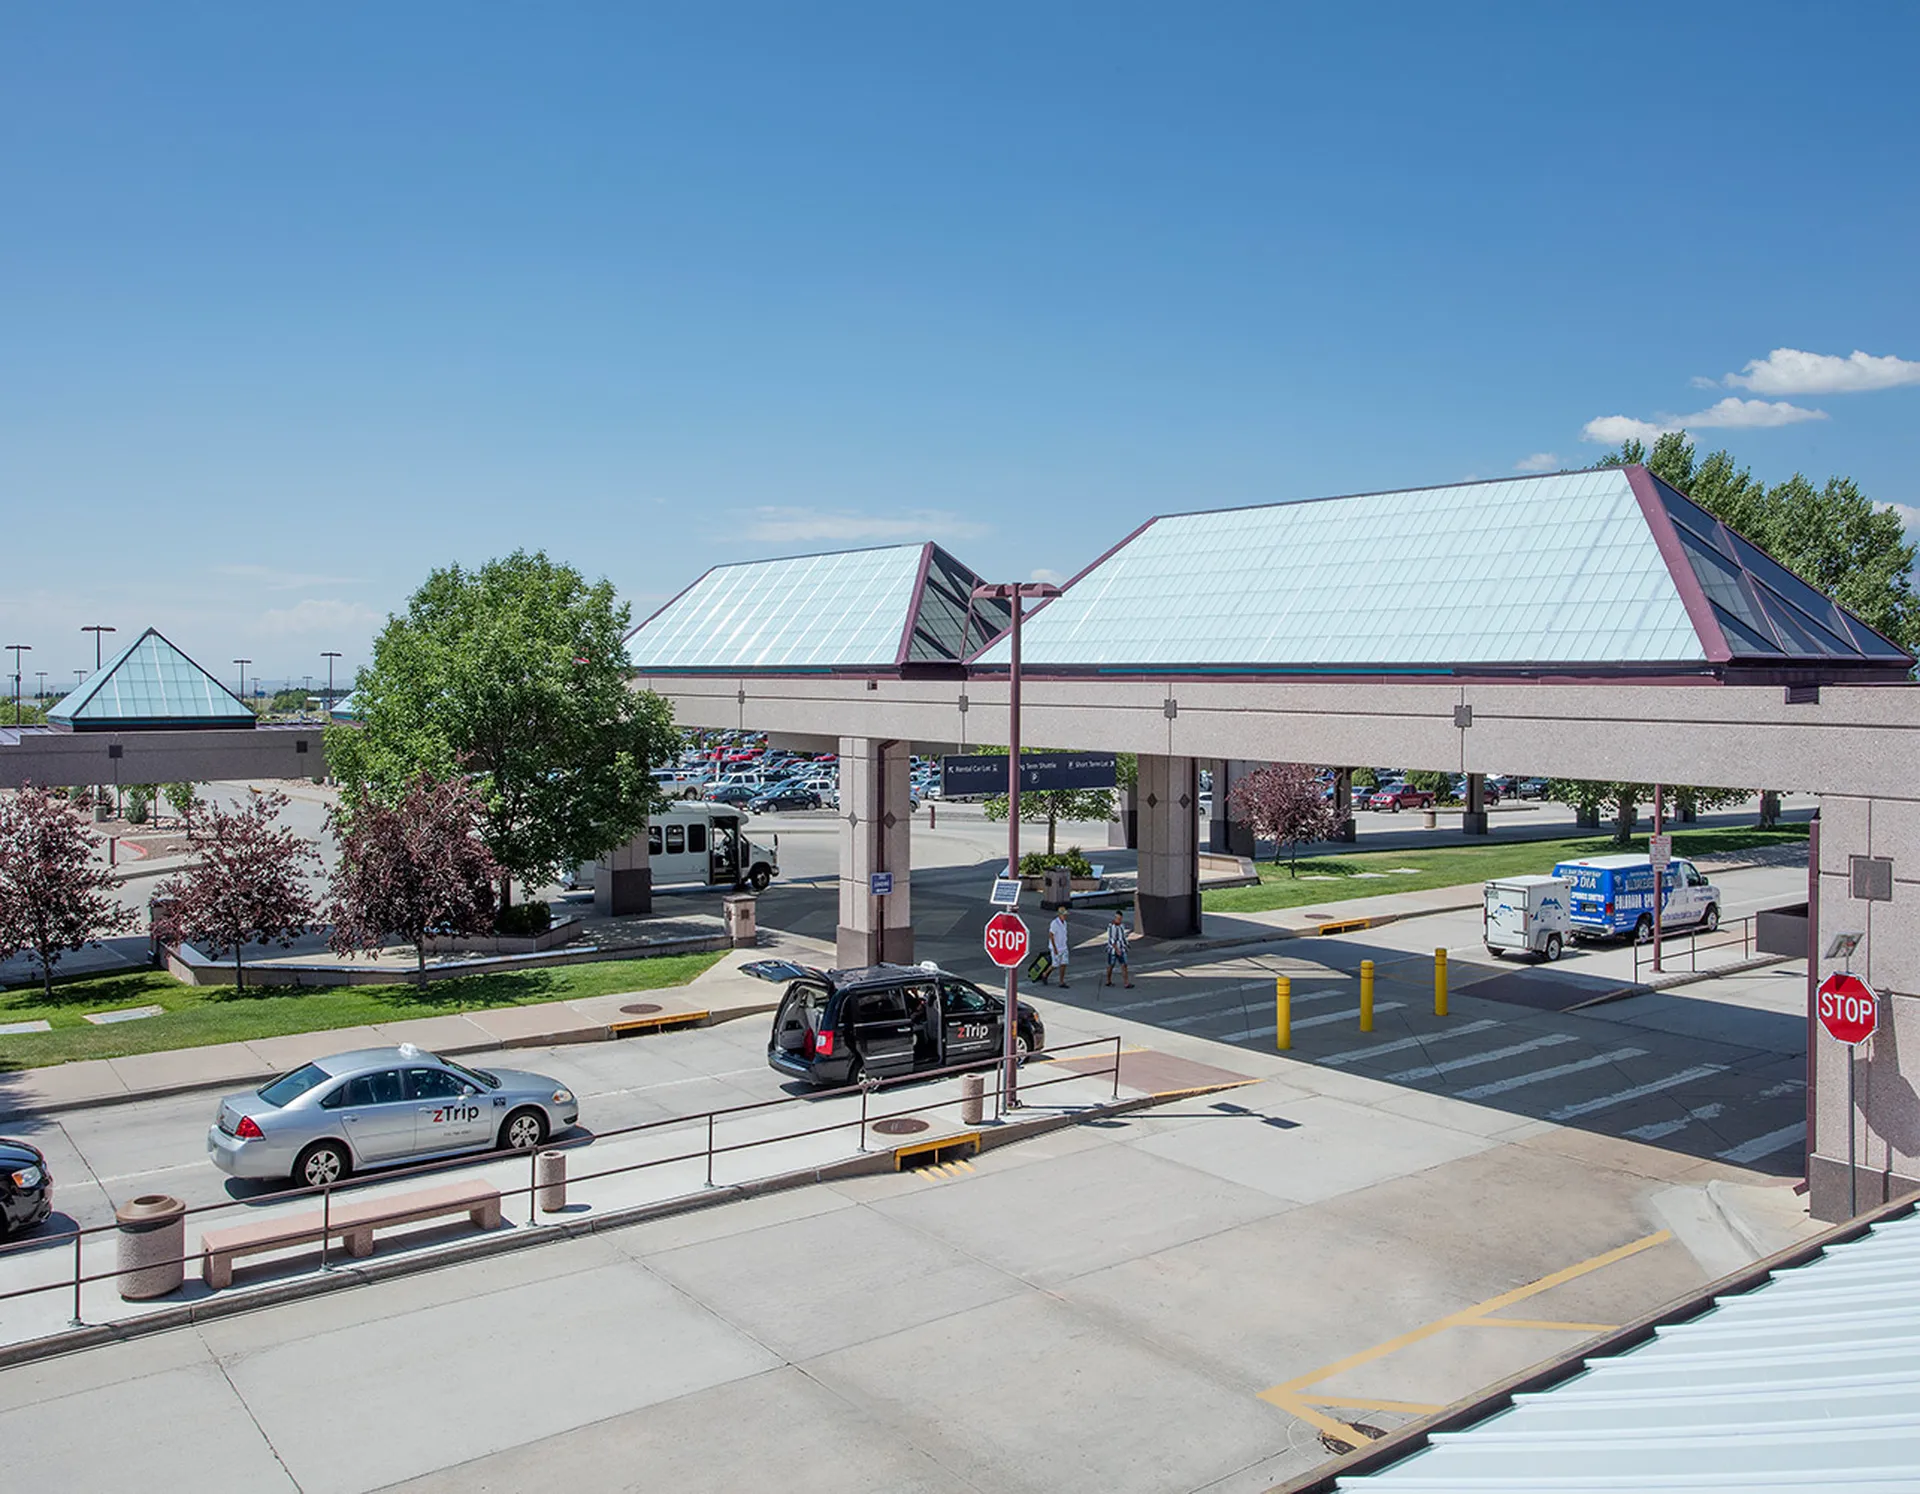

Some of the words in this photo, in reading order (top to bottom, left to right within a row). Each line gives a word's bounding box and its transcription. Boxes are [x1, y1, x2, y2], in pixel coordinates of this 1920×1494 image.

[955, 765, 972, 773] Rental
[1615, 894, 1642, 909] COLORADO
[988, 928, 1025, 951] STOP
[1821, 992, 1873, 1024] STOP
[957, 1022, 989, 1039] zTrip
[433, 1103, 479, 1122] zTrip
